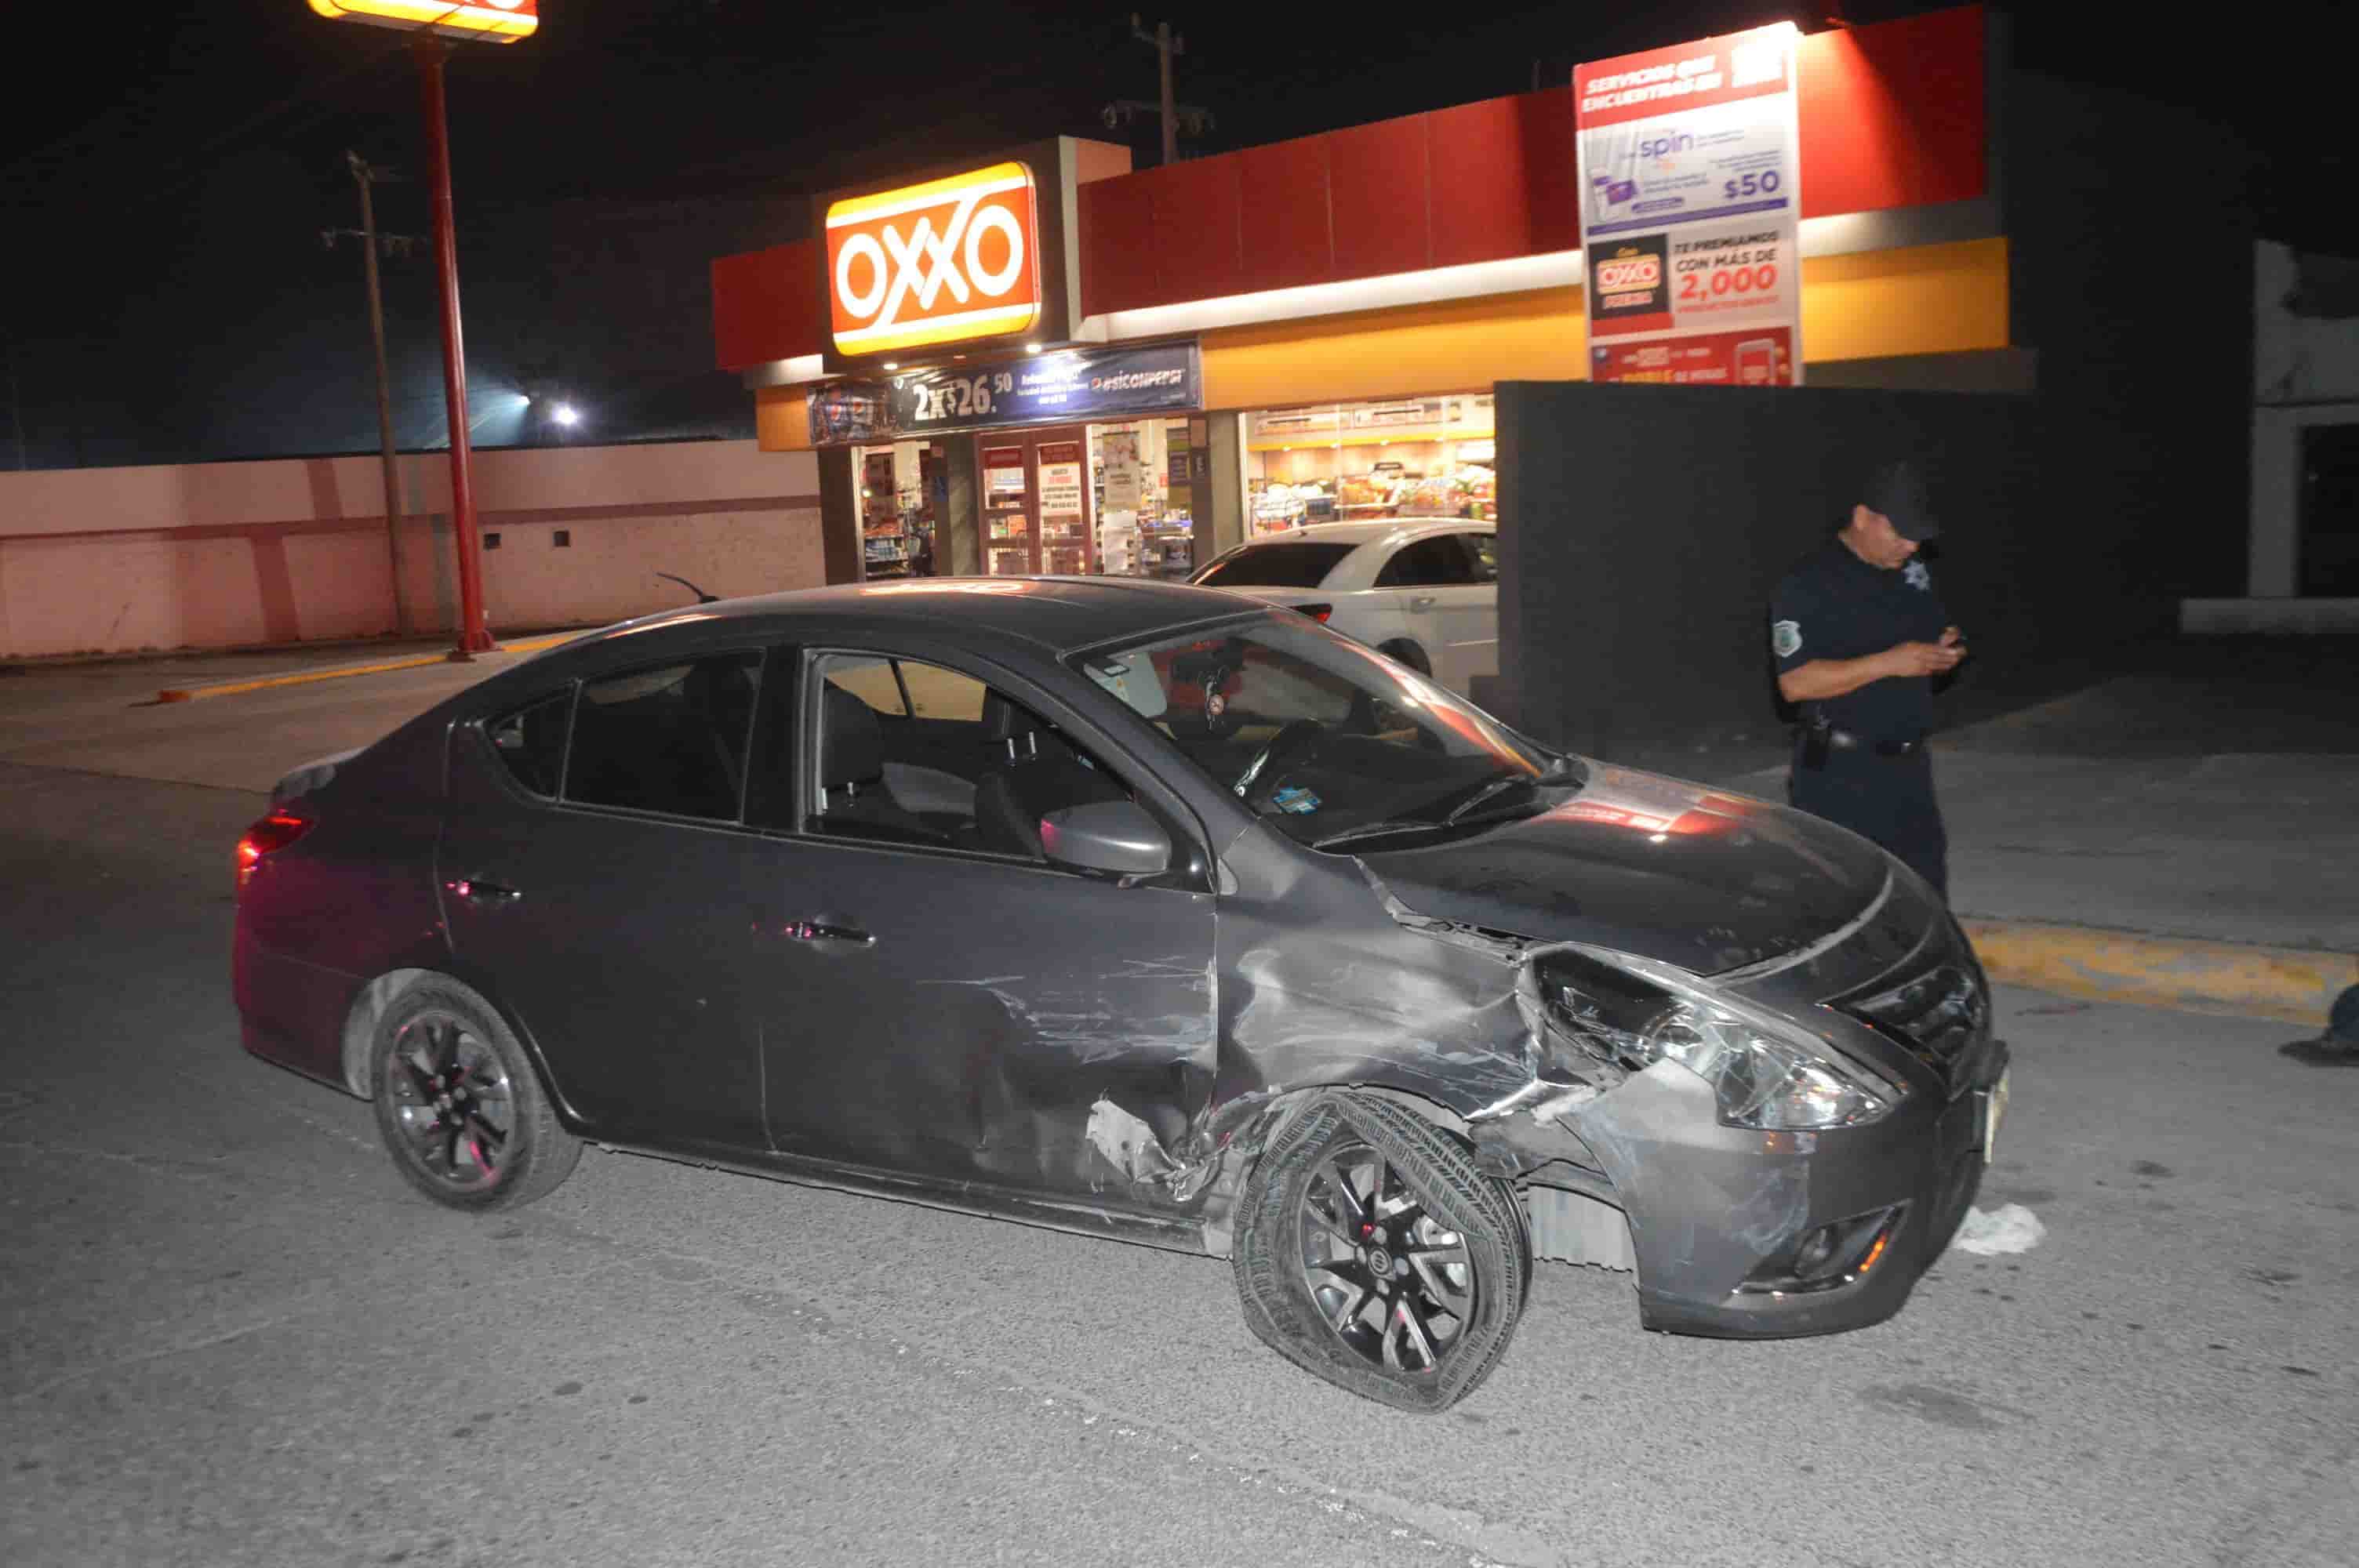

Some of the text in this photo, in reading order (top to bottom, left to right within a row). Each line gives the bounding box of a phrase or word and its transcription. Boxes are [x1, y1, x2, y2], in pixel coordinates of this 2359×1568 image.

[1641, 131, 1694, 158] spin
[1723, 170, 1780, 199] $50
[835, 194, 1024, 332] OXXO
[1676, 248, 1777, 273] CON MÁS DE
[1679, 263, 1779, 301] 2,000
